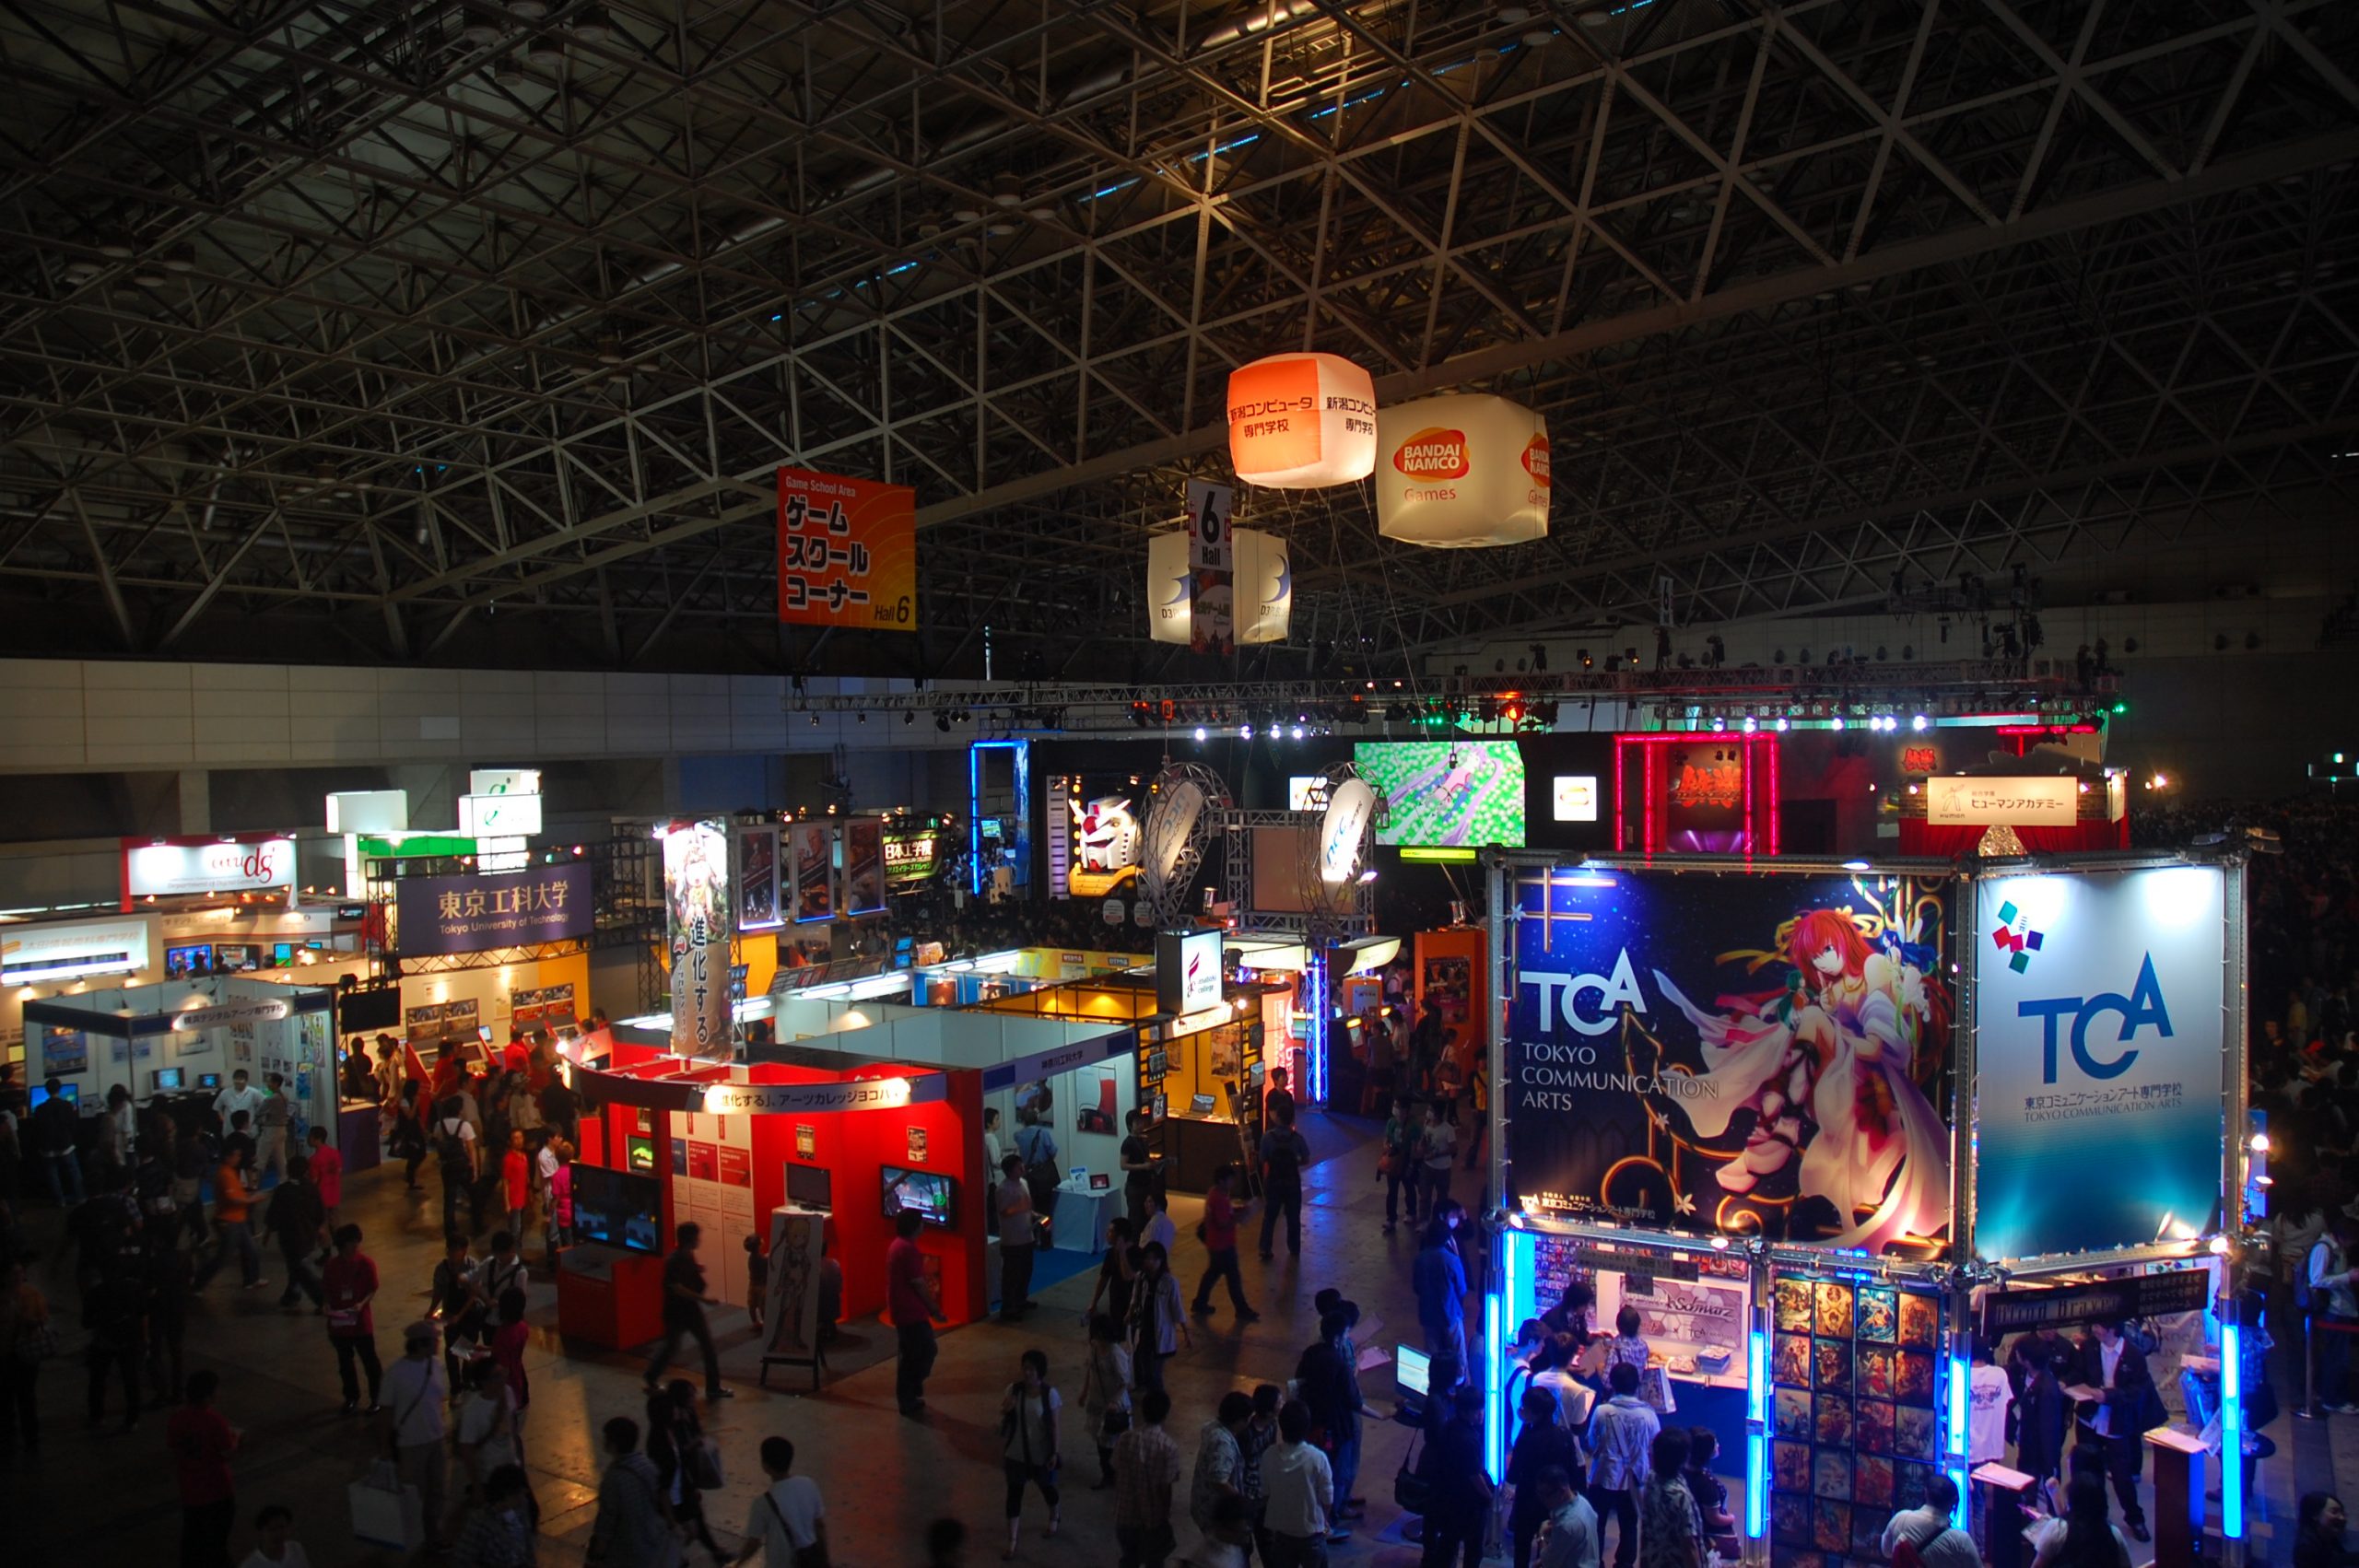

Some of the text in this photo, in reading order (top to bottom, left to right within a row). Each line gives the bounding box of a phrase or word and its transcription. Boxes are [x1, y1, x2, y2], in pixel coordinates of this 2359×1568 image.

[1230, 397, 1313, 422] 新潟コンピュータ
[1244, 418, 1290, 439] 専門学校
[1403, 444, 1461, 459] BANDAI
[1403, 456, 1461, 472] NAMCO
[786, 475, 856, 497] Game School Area
[1403, 487, 1457, 502] Games
[786, 495, 850, 535] ゲーム
[1201, 491, 1220, 544] 6
[786, 534, 870, 576] スクール
[1202, 545, 1221, 567] Hall
[786, 576, 870, 613] コーナー
[874, 595, 910, 624] Hall 6
[1971, 799, 2064, 810] ヒューマンアカデミー
[885, 839, 933, 860] 日本工学院
[439, 880, 569, 919] 東京工科大学
[440, 913, 569, 936] Tokyo University of Technology
[690, 916, 709, 1044] 進化する
[1520, 946, 1648, 1036] TCA
[2017, 950, 2174, 1084] TCA
[1521, 1042, 1596, 1065] TOKYO
[1521, 1066, 1719, 1099] COMMUNICATION
[1521, 1091, 1572, 1111] ARTS
[2025, 1082, 2182, 1111] 東京コミュニケーションアート専門学校
[2025, 1096, 2182, 1122] TOKYO COMMUNICATION ARTS
